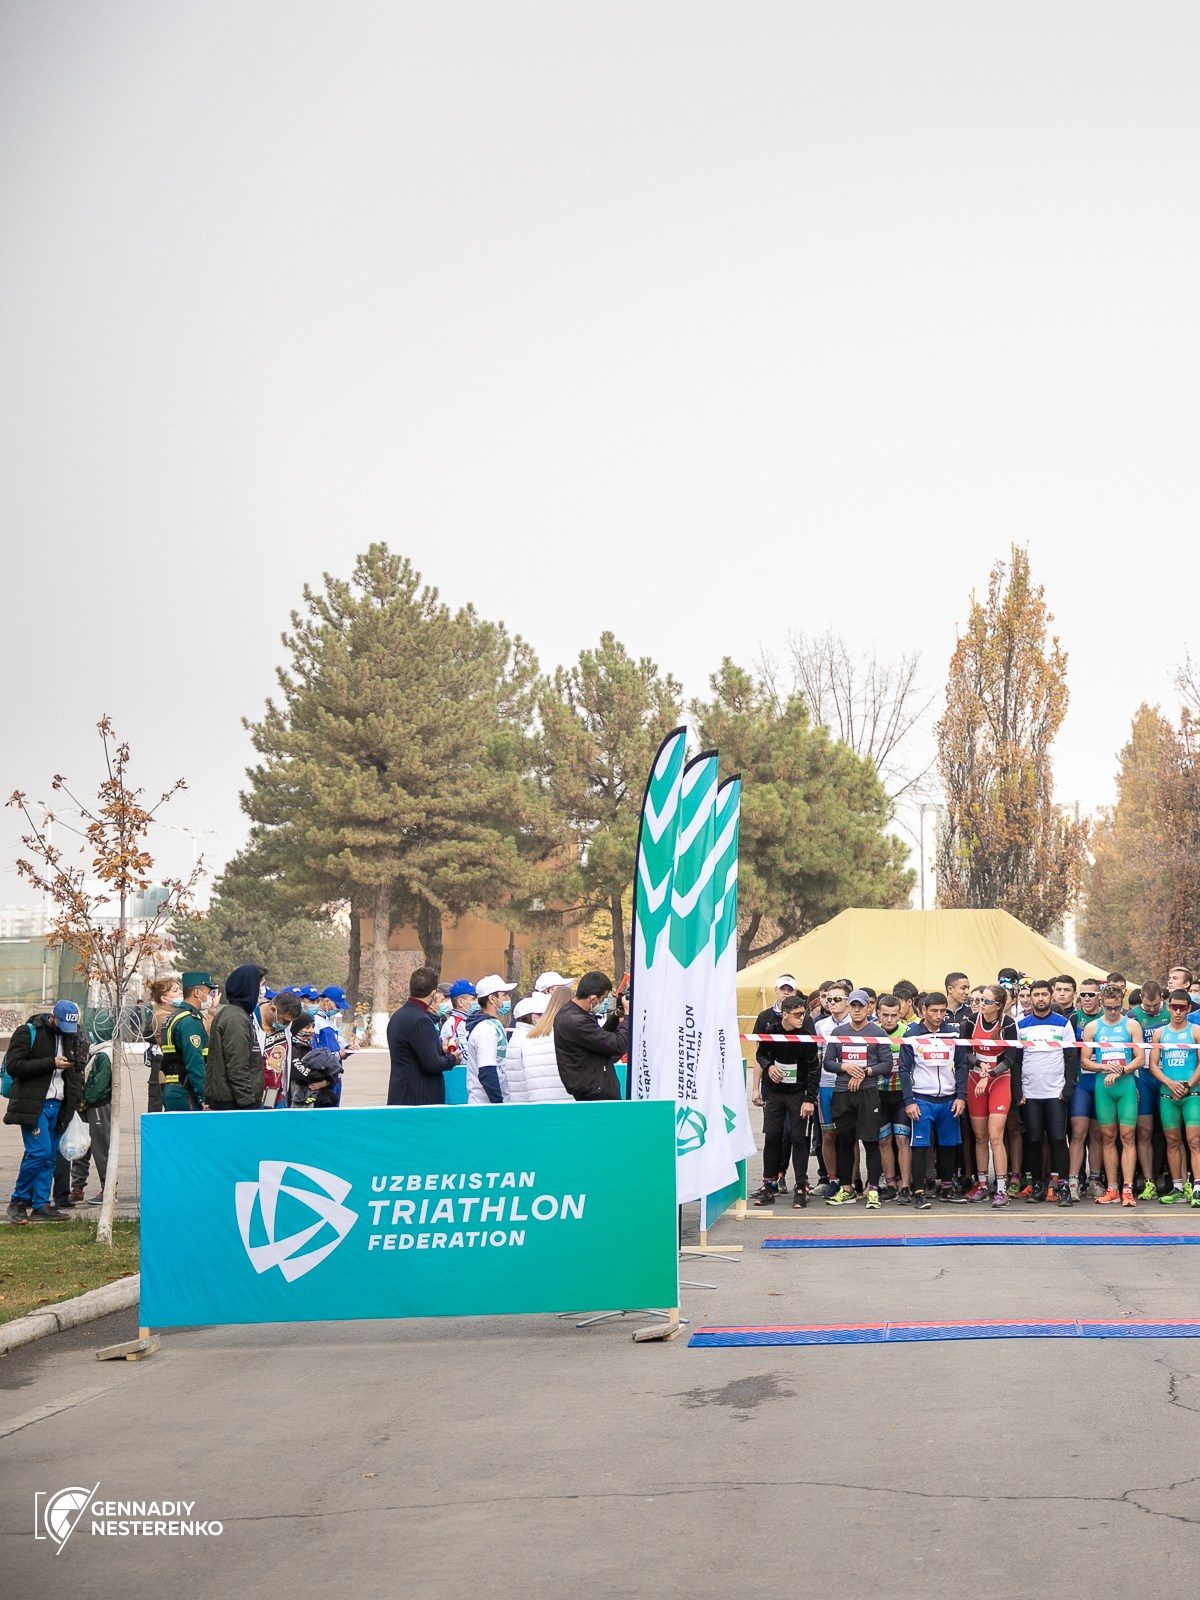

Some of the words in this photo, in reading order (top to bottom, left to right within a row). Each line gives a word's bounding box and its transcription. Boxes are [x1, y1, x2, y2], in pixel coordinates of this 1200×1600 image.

[685, 1005, 696, 1100] TRIATHLON
[1167, 1058, 1186, 1067] UZB
[371, 1171, 536, 1192] UZBEKISTAN
[367, 1194, 587, 1226] TRIATHLON
[367, 1229, 526, 1251] FEDERATION
